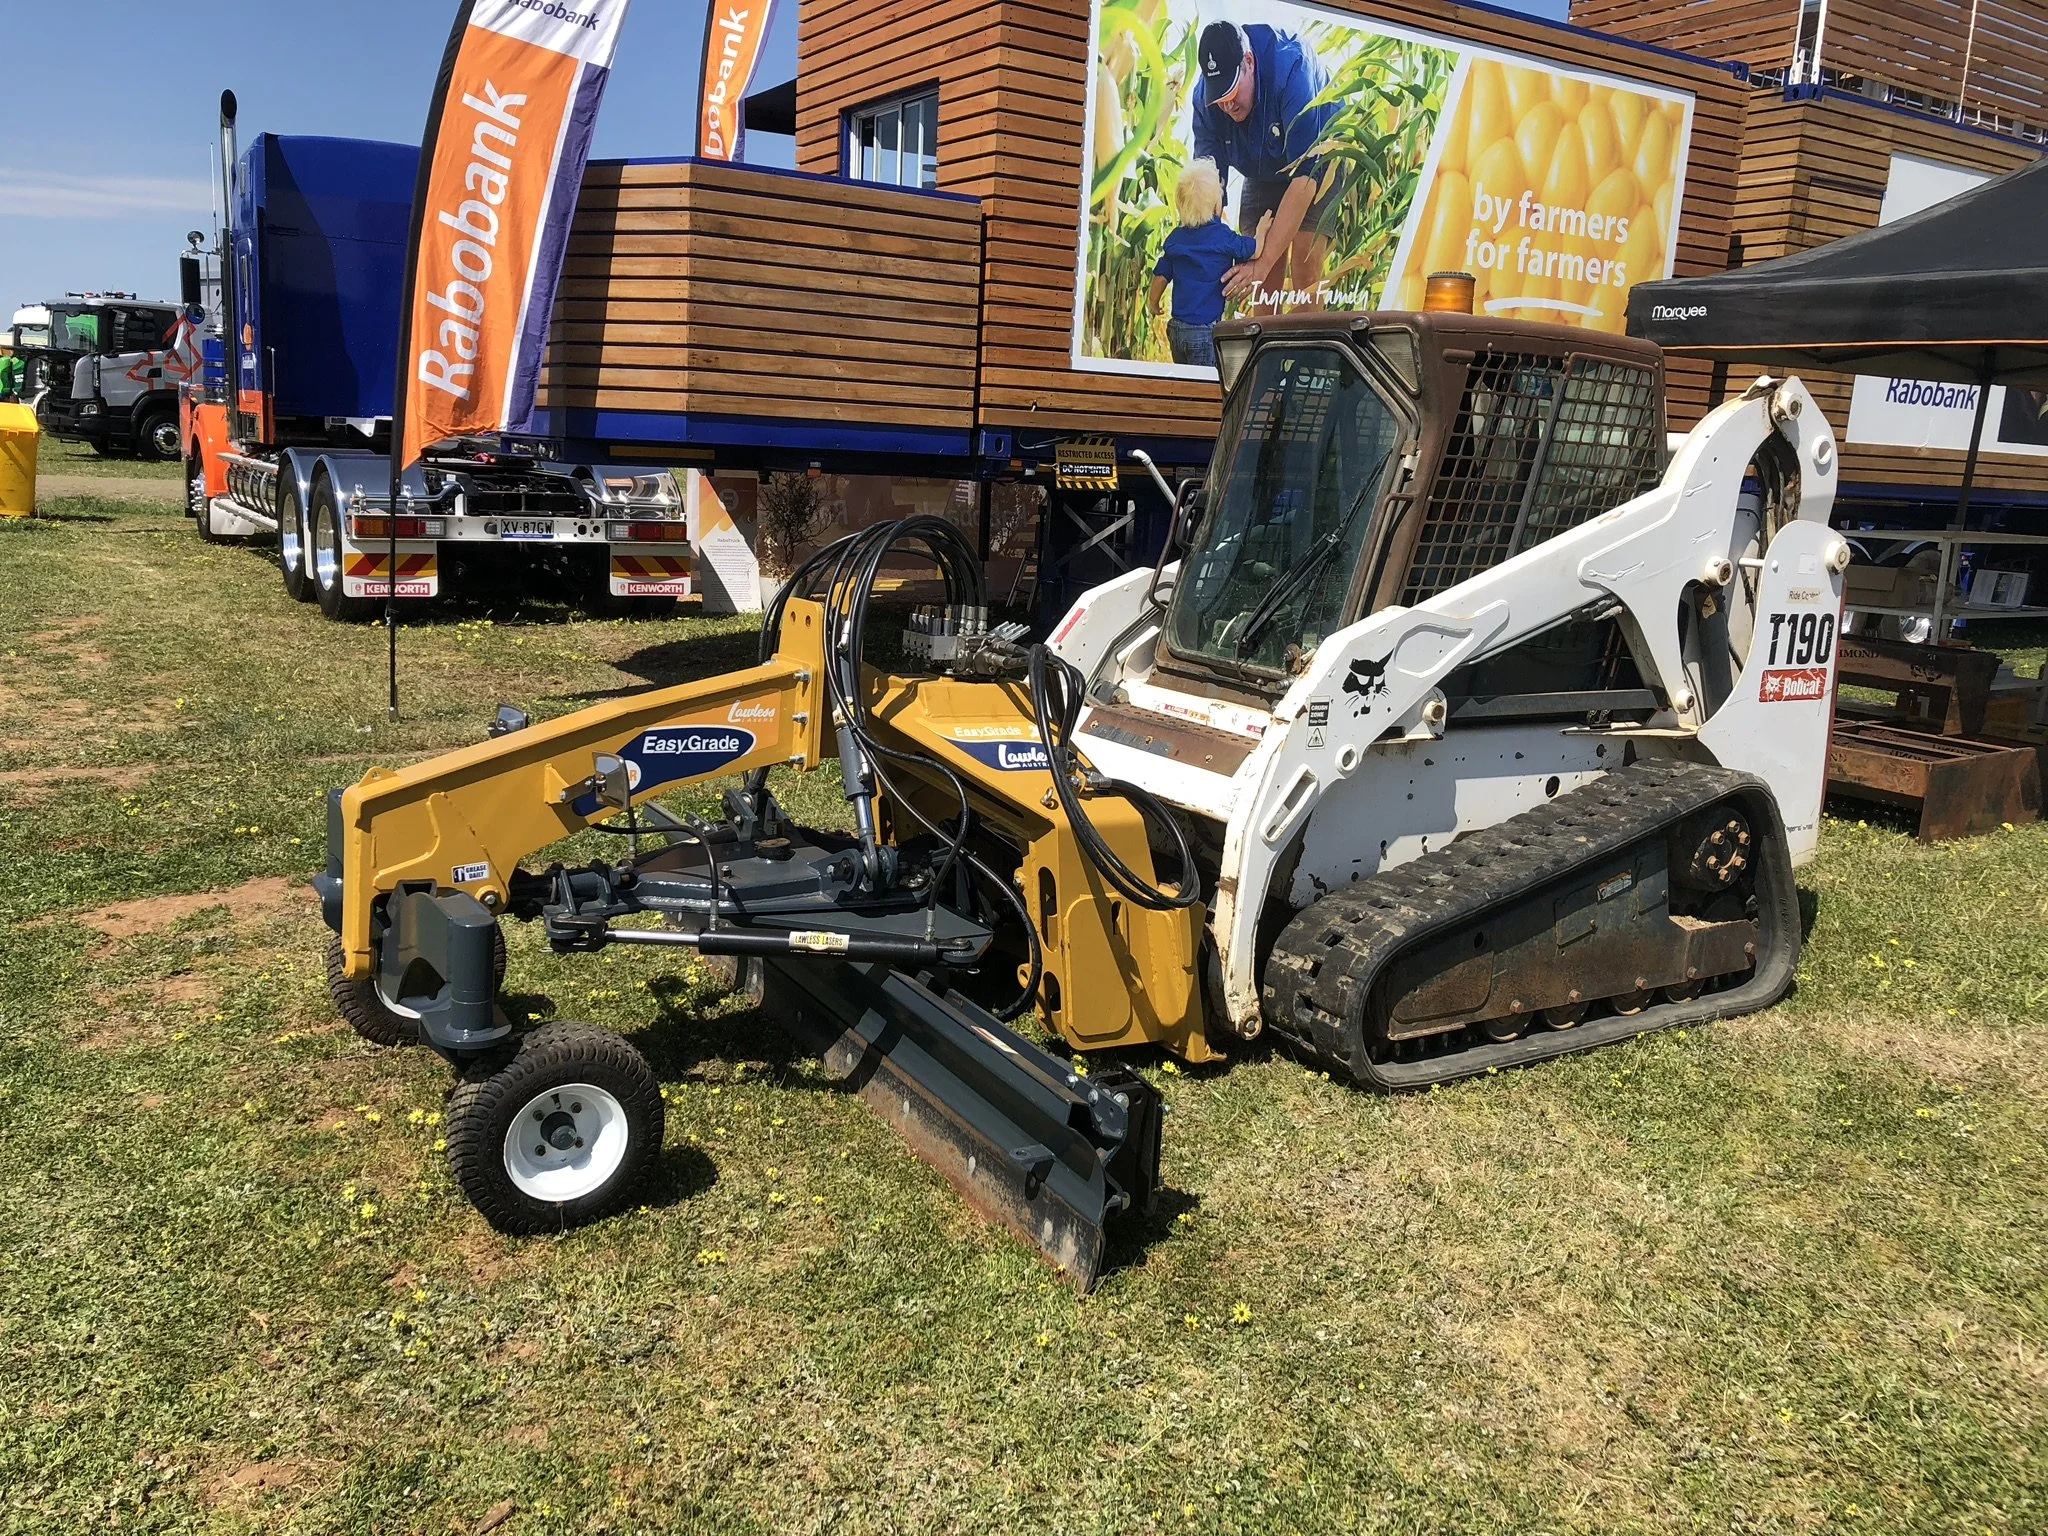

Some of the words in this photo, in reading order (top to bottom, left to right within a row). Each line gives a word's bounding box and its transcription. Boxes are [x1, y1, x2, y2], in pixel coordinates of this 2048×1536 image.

[1473, 181, 1512, 234] by
[1519, 190, 1629, 244] farmers
[417, 78, 528, 400] Rabobank
[1466, 228, 1510, 270] for
[1517, 236, 1627, 287] farmers
[1248, 280, 1313, 315] Ingram
[1316, 279, 1369, 311] Family
[1652, 305, 1707, 320] Marquee
[1885, 377, 1978, 410] Rabobank
[1058, 450, 1093, 459] RESTRICTED
[1094, 451, 1114, 460] ACCESS
[1062, 464, 1074, 473] DO
[1074, 465, 1088, 473] NOT
[629, 584, 683, 593] KENWORTH
[1768, 613, 1835, 665] T190
[1783, 676, 1820, 697] Bobcat
[727, 700, 775, 722] Lawless
[953, 725, 1022, 738] EasyGrade
[642, 735, 740, 754] EasyGrade
[998, 744, 1048, 769] Lawle
[466, 865, 486, 873] GREASE
[795, 935, 821, 944] LAWLESS
[822, 936, 843, 946] LASERS
